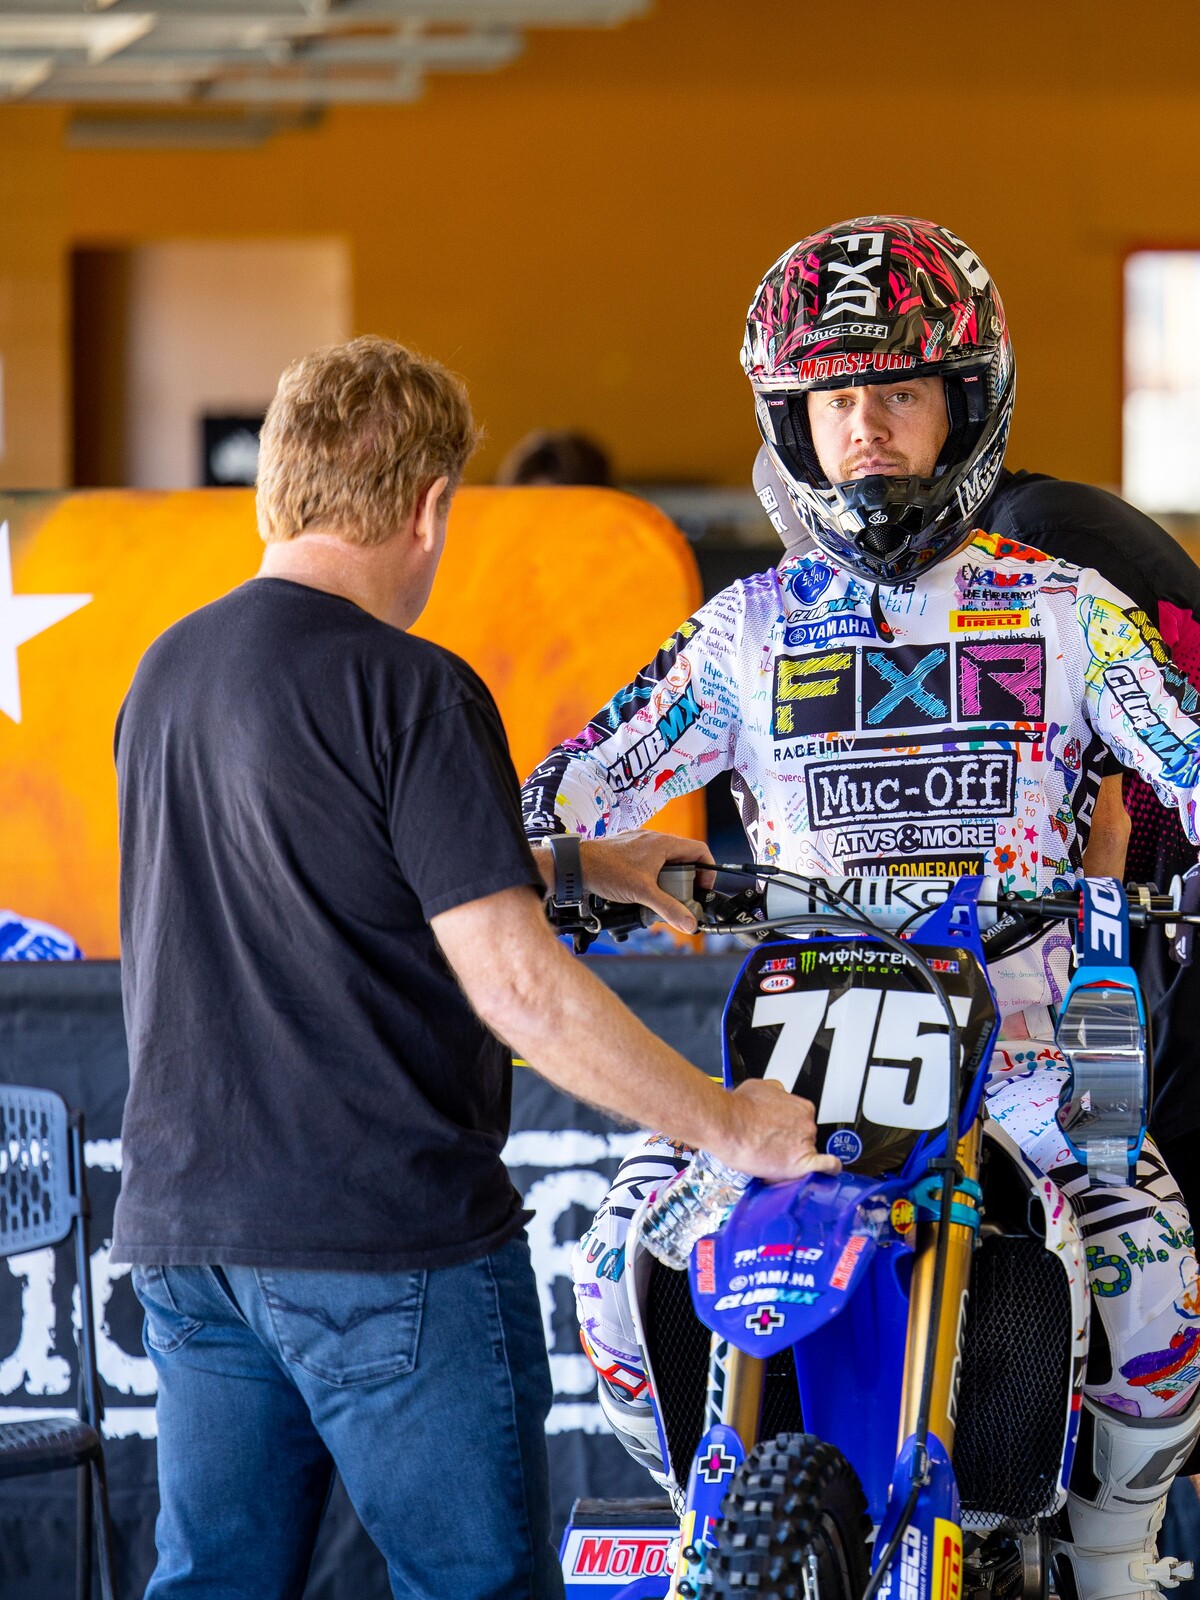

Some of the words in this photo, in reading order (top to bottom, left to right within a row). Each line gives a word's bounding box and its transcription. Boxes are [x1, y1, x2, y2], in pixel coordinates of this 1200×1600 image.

[807, 326, 884, 344] Muc-Off
[808, 618, 871, 640] YAMAHA
[957, 614, 1022, 628] PIRELLI
[774, 642, 1044, 735] FXR
[774, 742, 816, 762] RACE
[818, 760, 1004, 817] Muc-Off
[834, 825, 996, 856] ATVS&MORE
[758, 956, 797, 974] AMA
[831, 965, 904, 975] ENERGY
[751, 987, 973, 1131] 715
[749, 1270, 816, 1289] YAMAHA
[573, 1537, 677, 1577] MoTo
